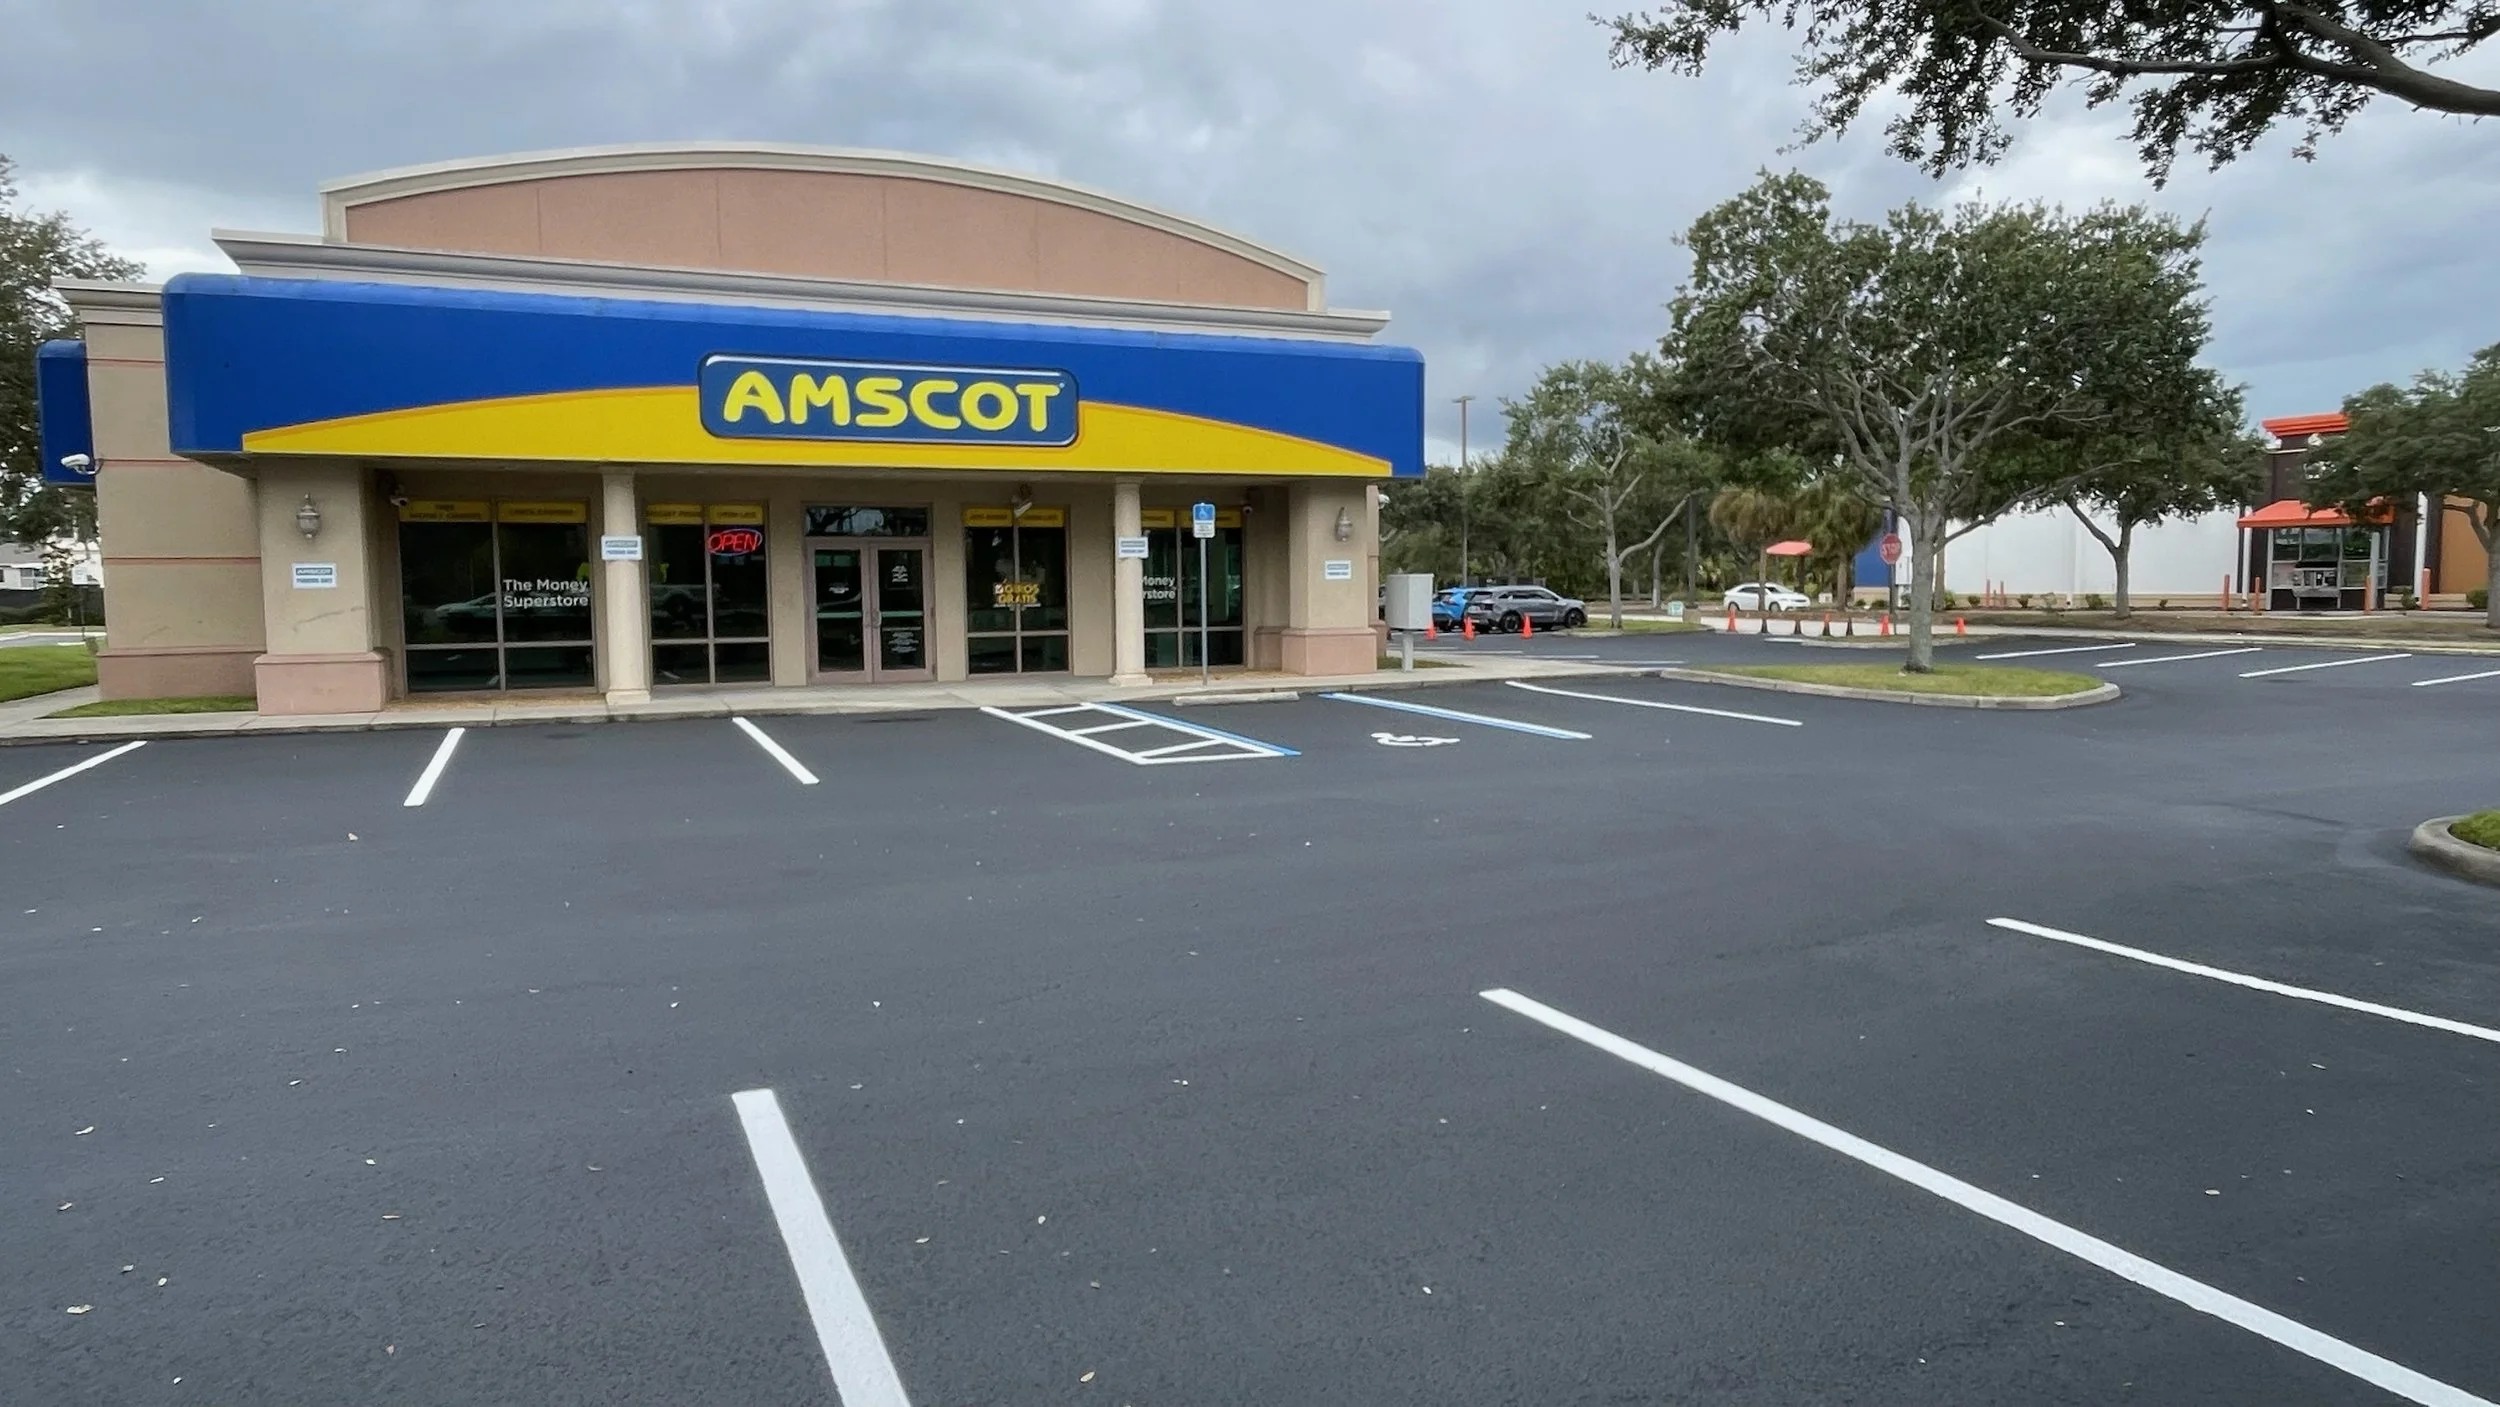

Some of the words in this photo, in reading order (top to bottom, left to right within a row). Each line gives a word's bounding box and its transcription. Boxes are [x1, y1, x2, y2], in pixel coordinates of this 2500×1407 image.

[723, 370, 1061, 432] AMSCOT
[709, 533, 758, 551] OPEN
[1882, 542, 1900, 555] STOP
[503, 579, 532, 591] The
[536, 578, 588, 592] Money
[503, 595, 589, 609] Superstore
